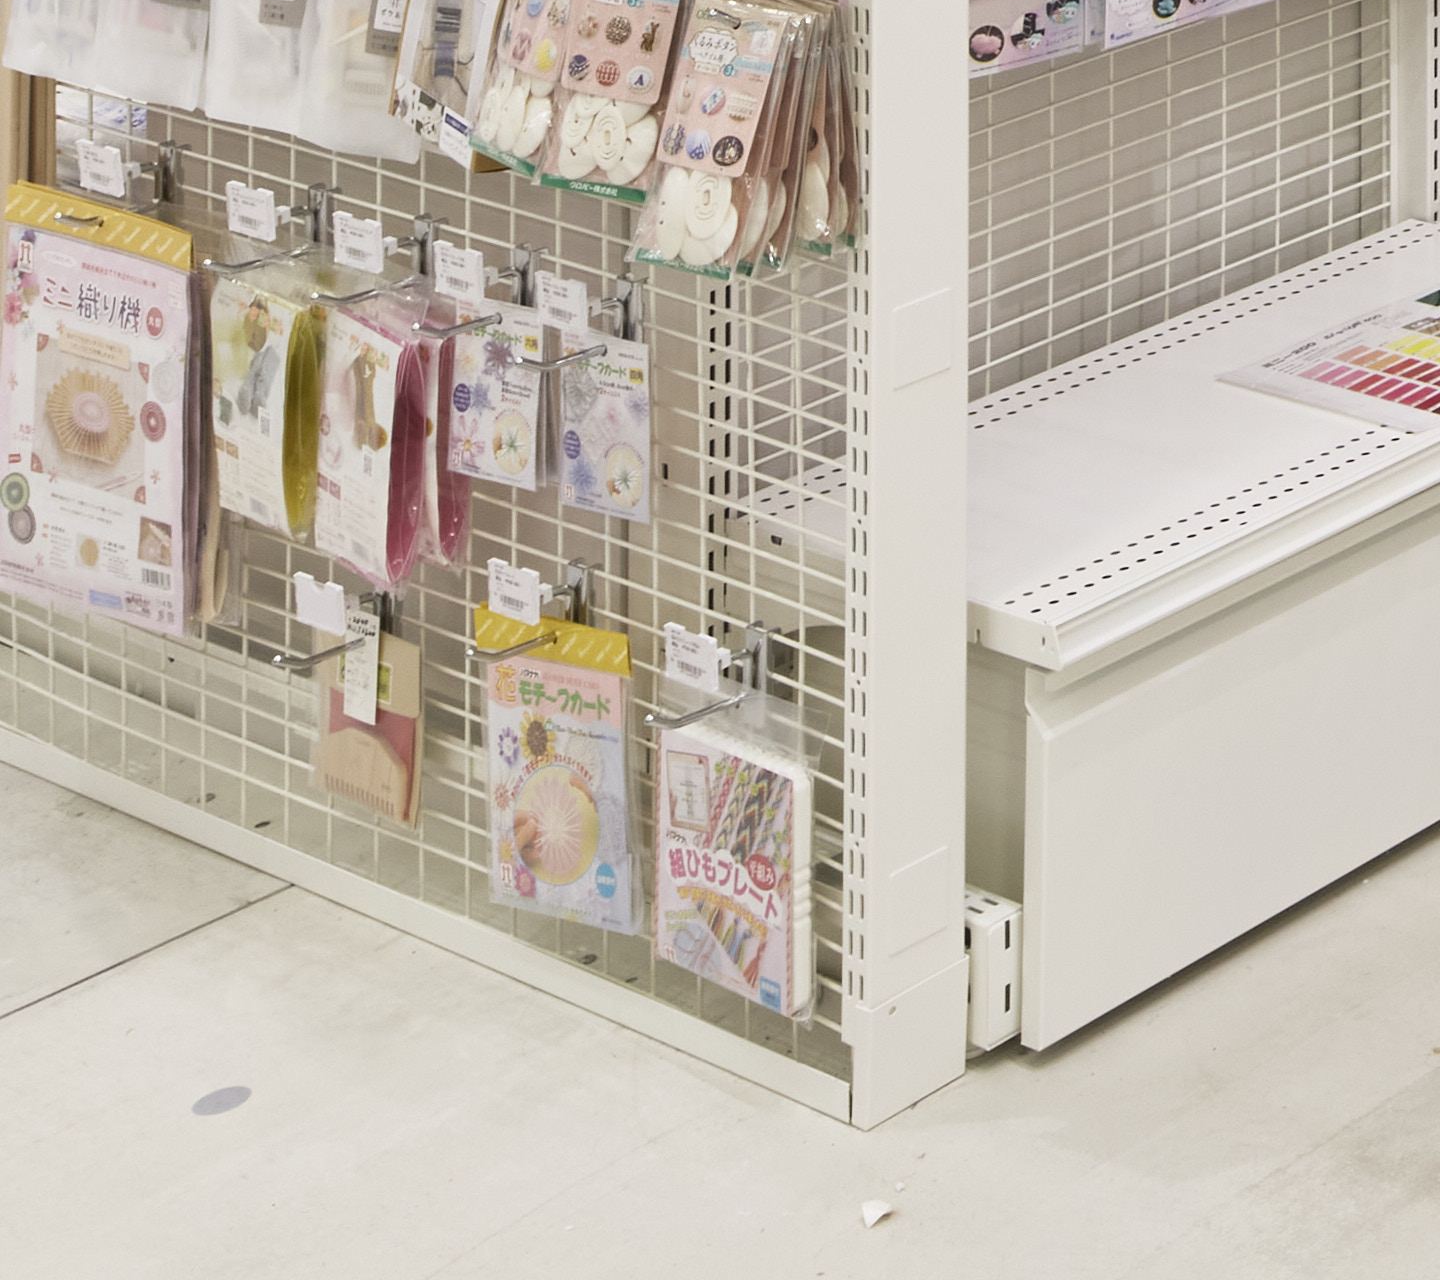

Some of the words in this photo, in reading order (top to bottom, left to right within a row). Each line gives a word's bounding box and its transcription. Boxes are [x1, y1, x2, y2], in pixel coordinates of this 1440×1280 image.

[668, 847, 781, 922] 組ひもプレート
